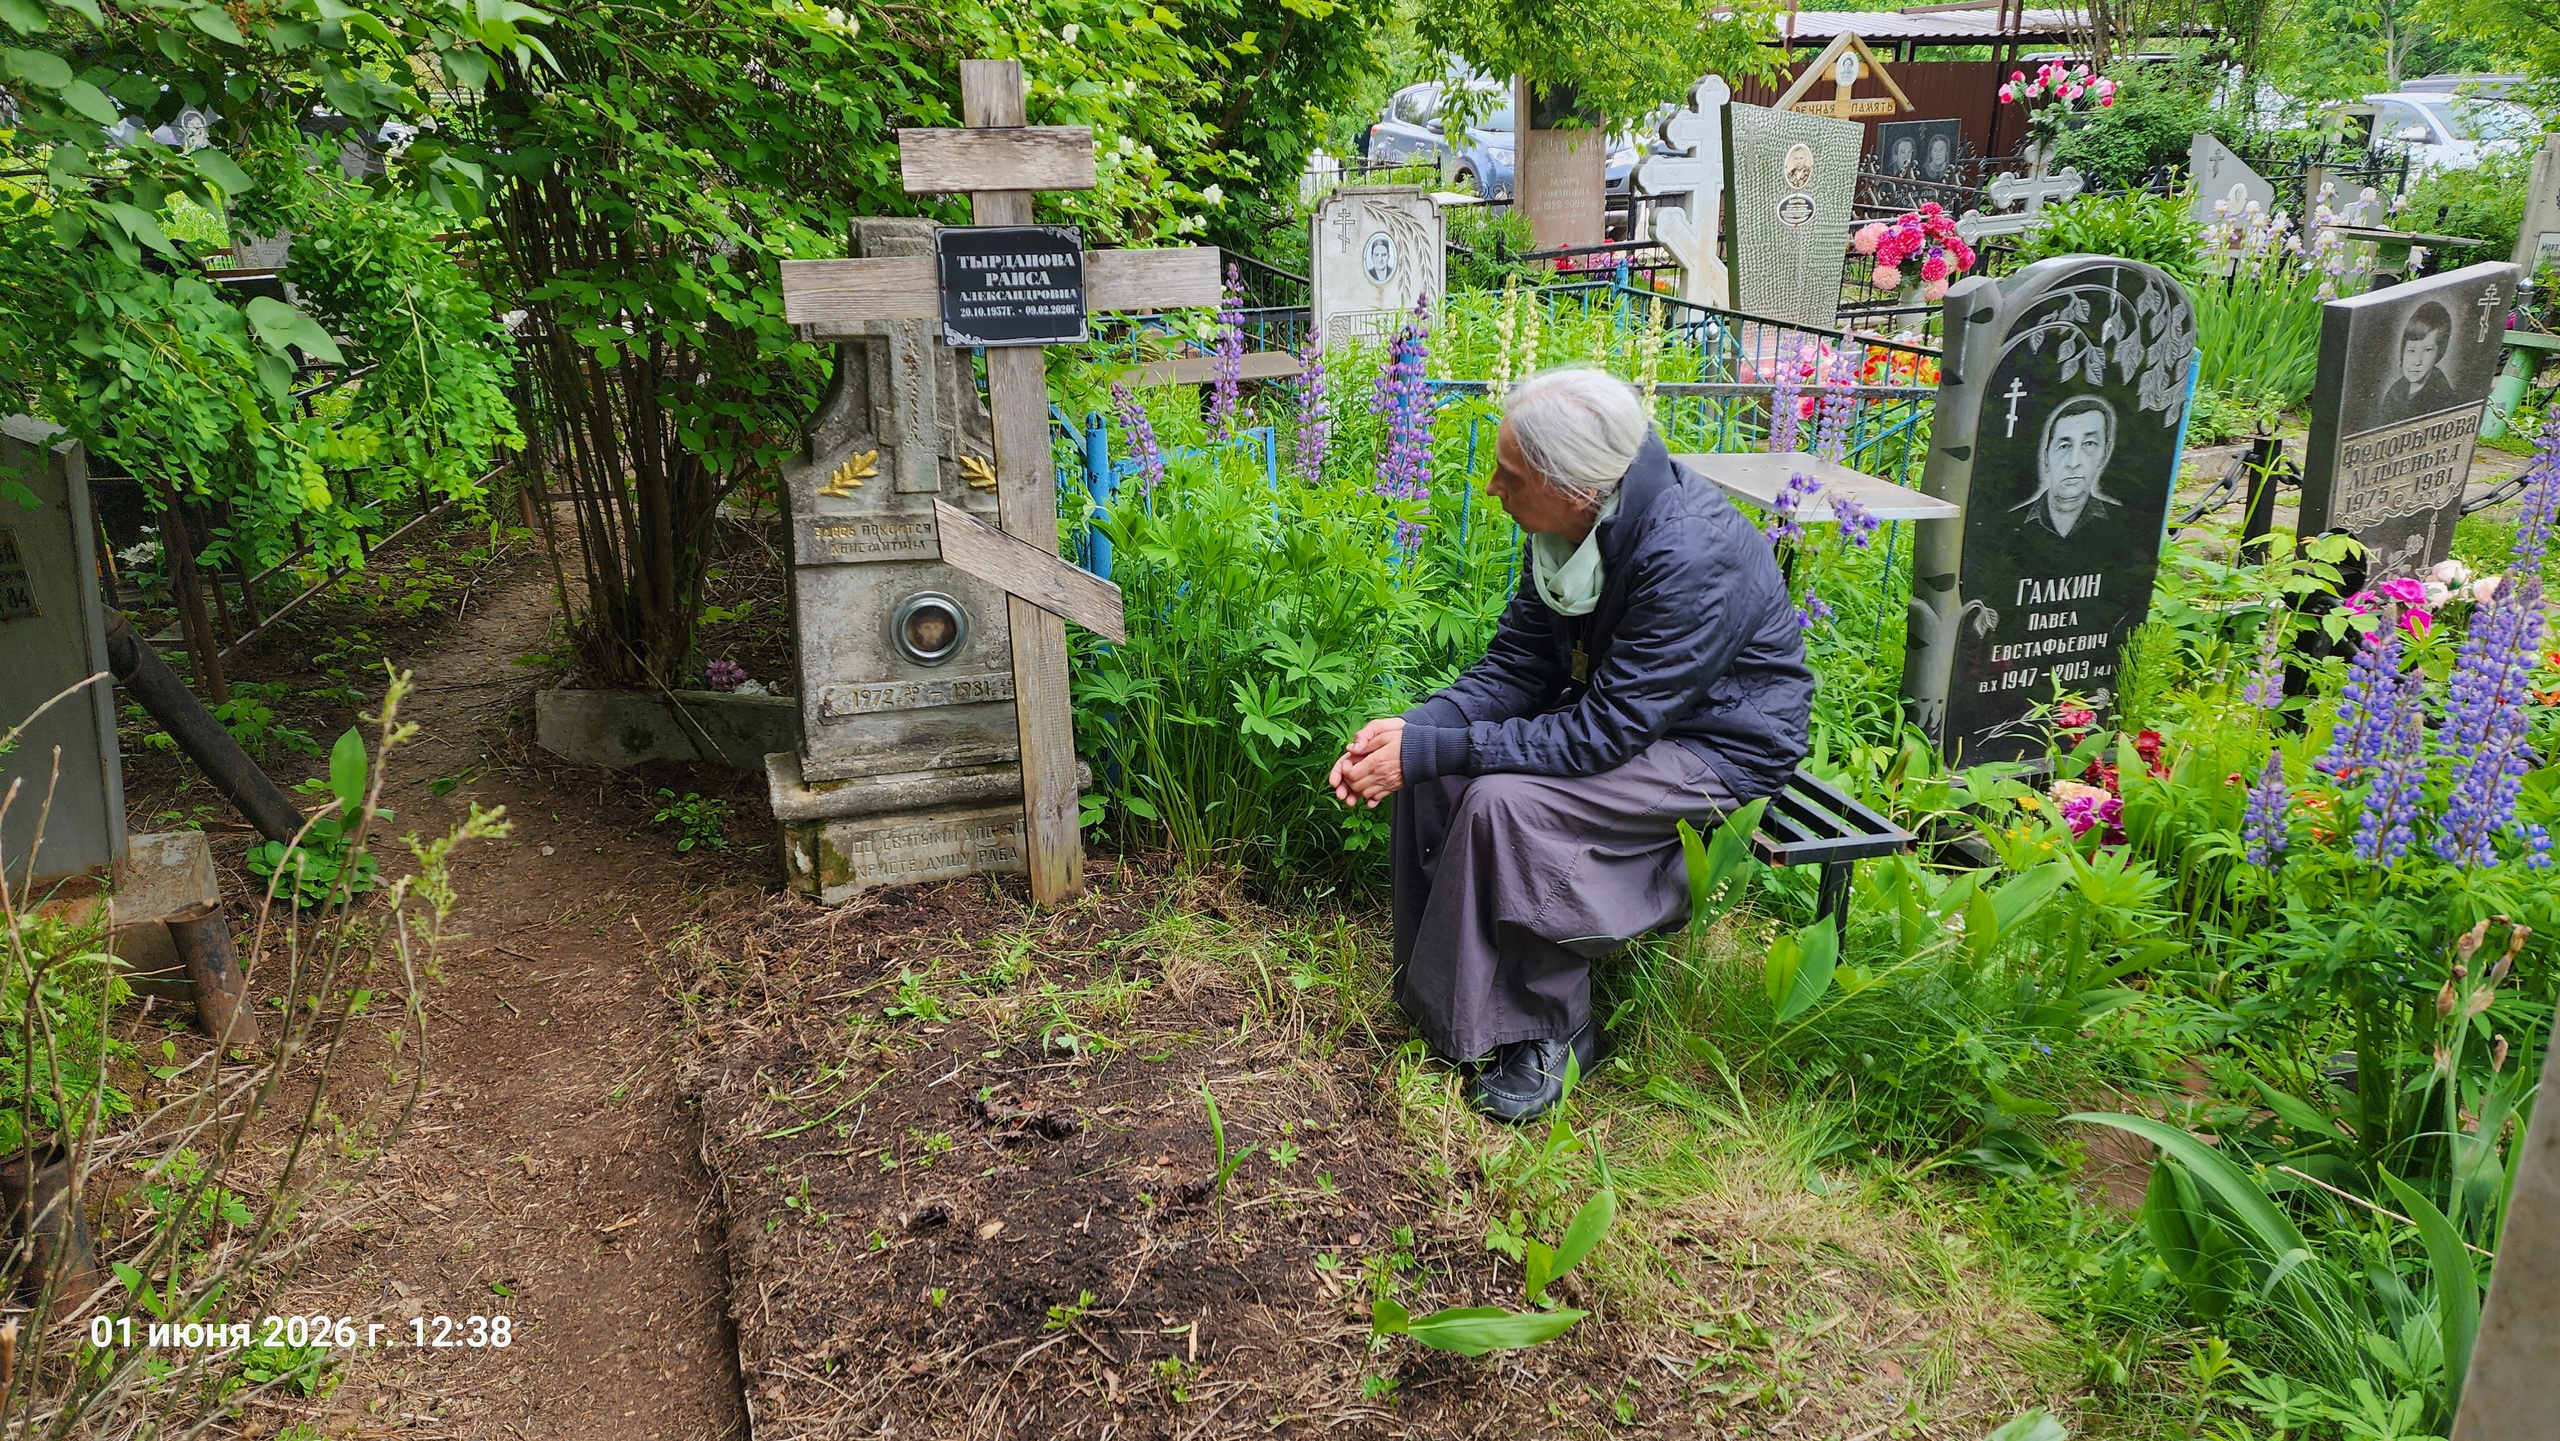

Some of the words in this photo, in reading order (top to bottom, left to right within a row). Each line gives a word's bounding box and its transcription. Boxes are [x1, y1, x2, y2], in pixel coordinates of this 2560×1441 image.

[956, 252, 1076, 270] ТЫРДАНОВА
[985, 270, 1052, 287] РАИСА
[958, 288, 1078, 302] АЛЕКСАНДРОВНА
[2346, 484, 2390, 514] 1975
[2415, 465, 2454, 494] 1981
[814, 525, 856, 540] ЗДЕСЬ
[861, 523, 931, 536] ПОКОИТСЯ
[2016, 573, 2102, 607] ГАЛКИН
[2027, 611, 2078, 631] ПАВЕЛ
[1990, 632, 2109, 663] ЕВСТАФЬЕВИЧ
[2001, 667, 2038, 691] 1947
[2056, 660, 2090, 682] 2013
[852, 840, 874, 855] СО
[883, 829, 958, 852] СВЯТЫМИ
[924, 852, 970, 871] ДУШУ
[977, 846, 1019, 866] РАБА
